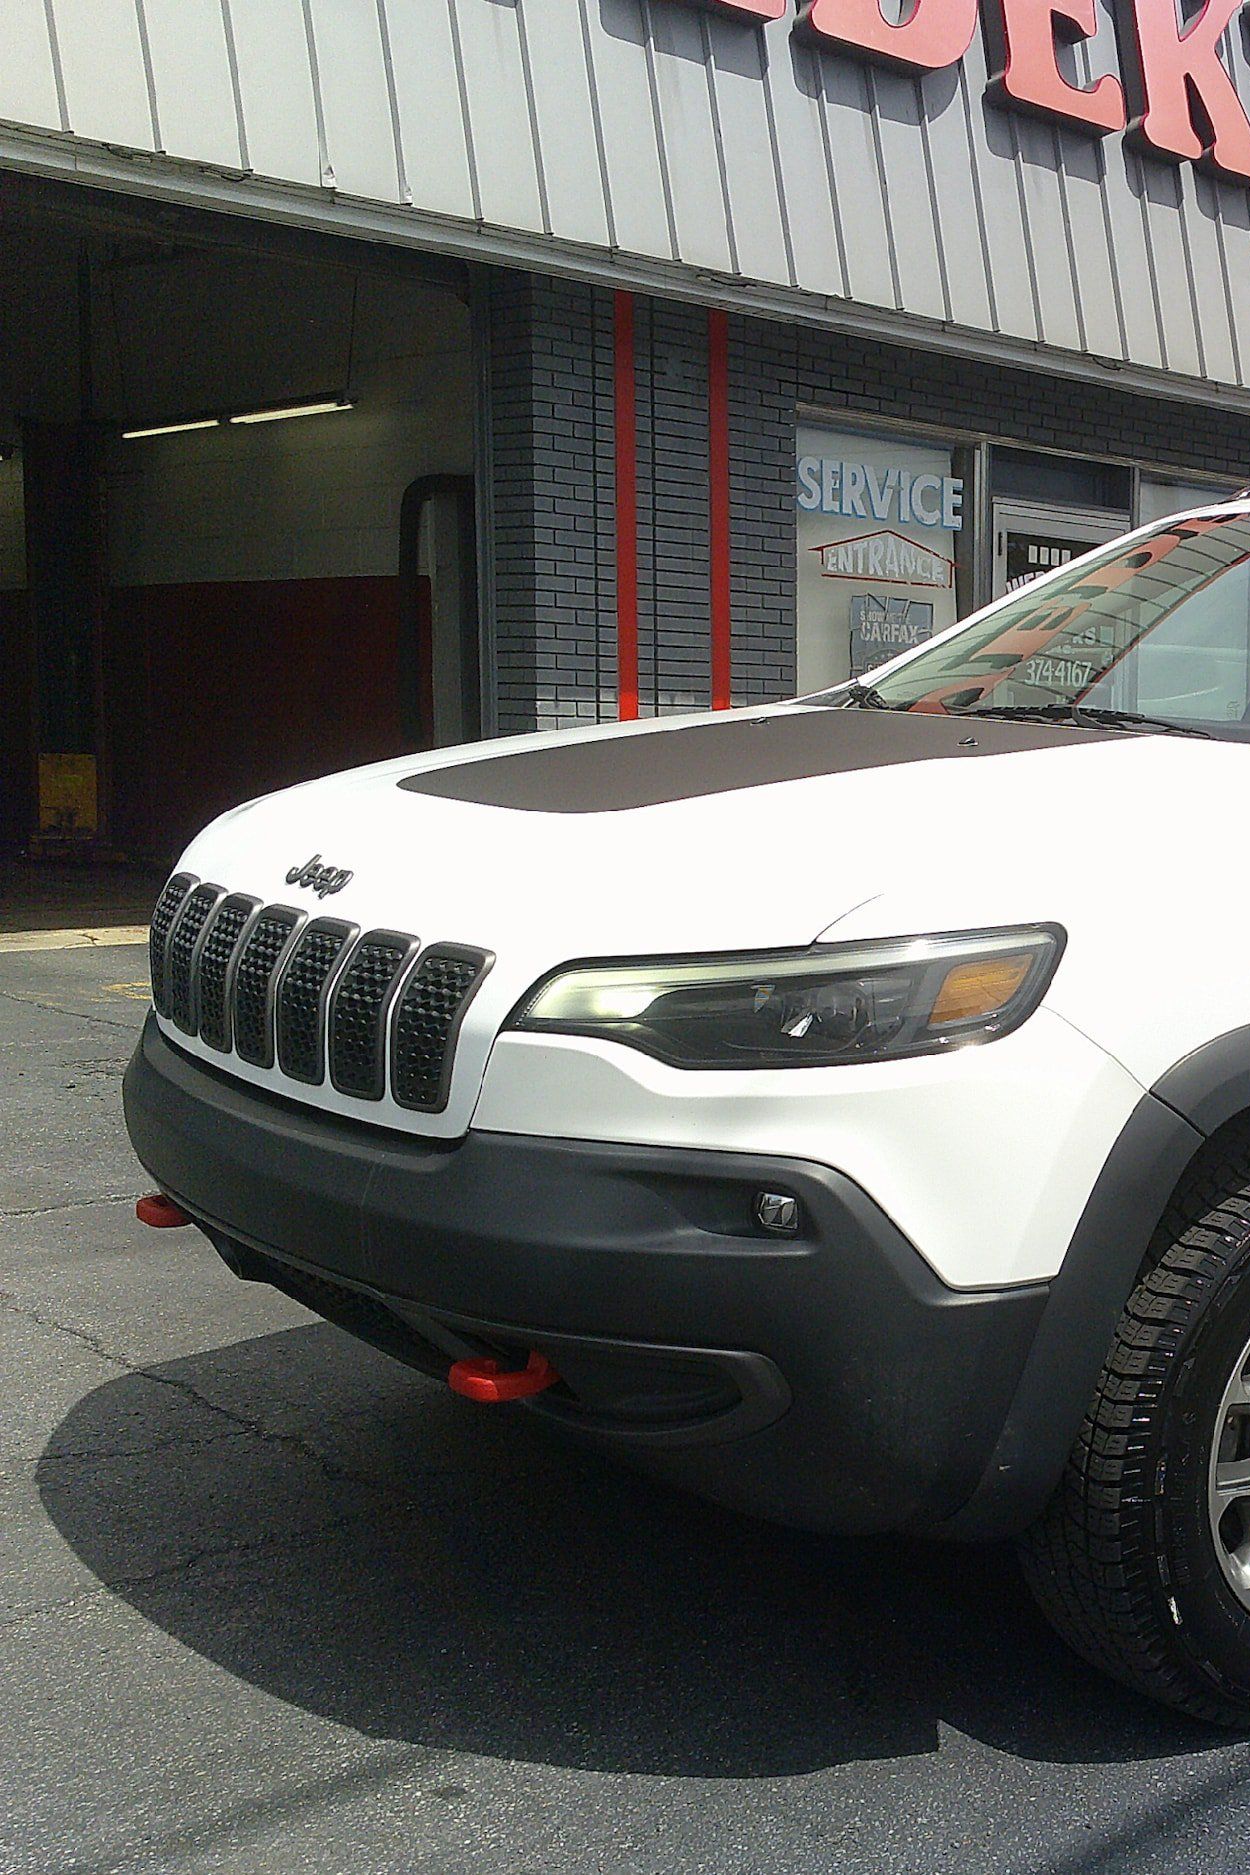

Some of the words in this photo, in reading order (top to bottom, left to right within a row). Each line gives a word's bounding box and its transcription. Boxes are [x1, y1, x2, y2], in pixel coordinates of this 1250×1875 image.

[797, 456, 964, 531] SERVICE
[827, 535, 944, 582] ENTRANCE
[860, 622, 919, 643] CARFAX
[285, 854, 354, 900] Jeep
